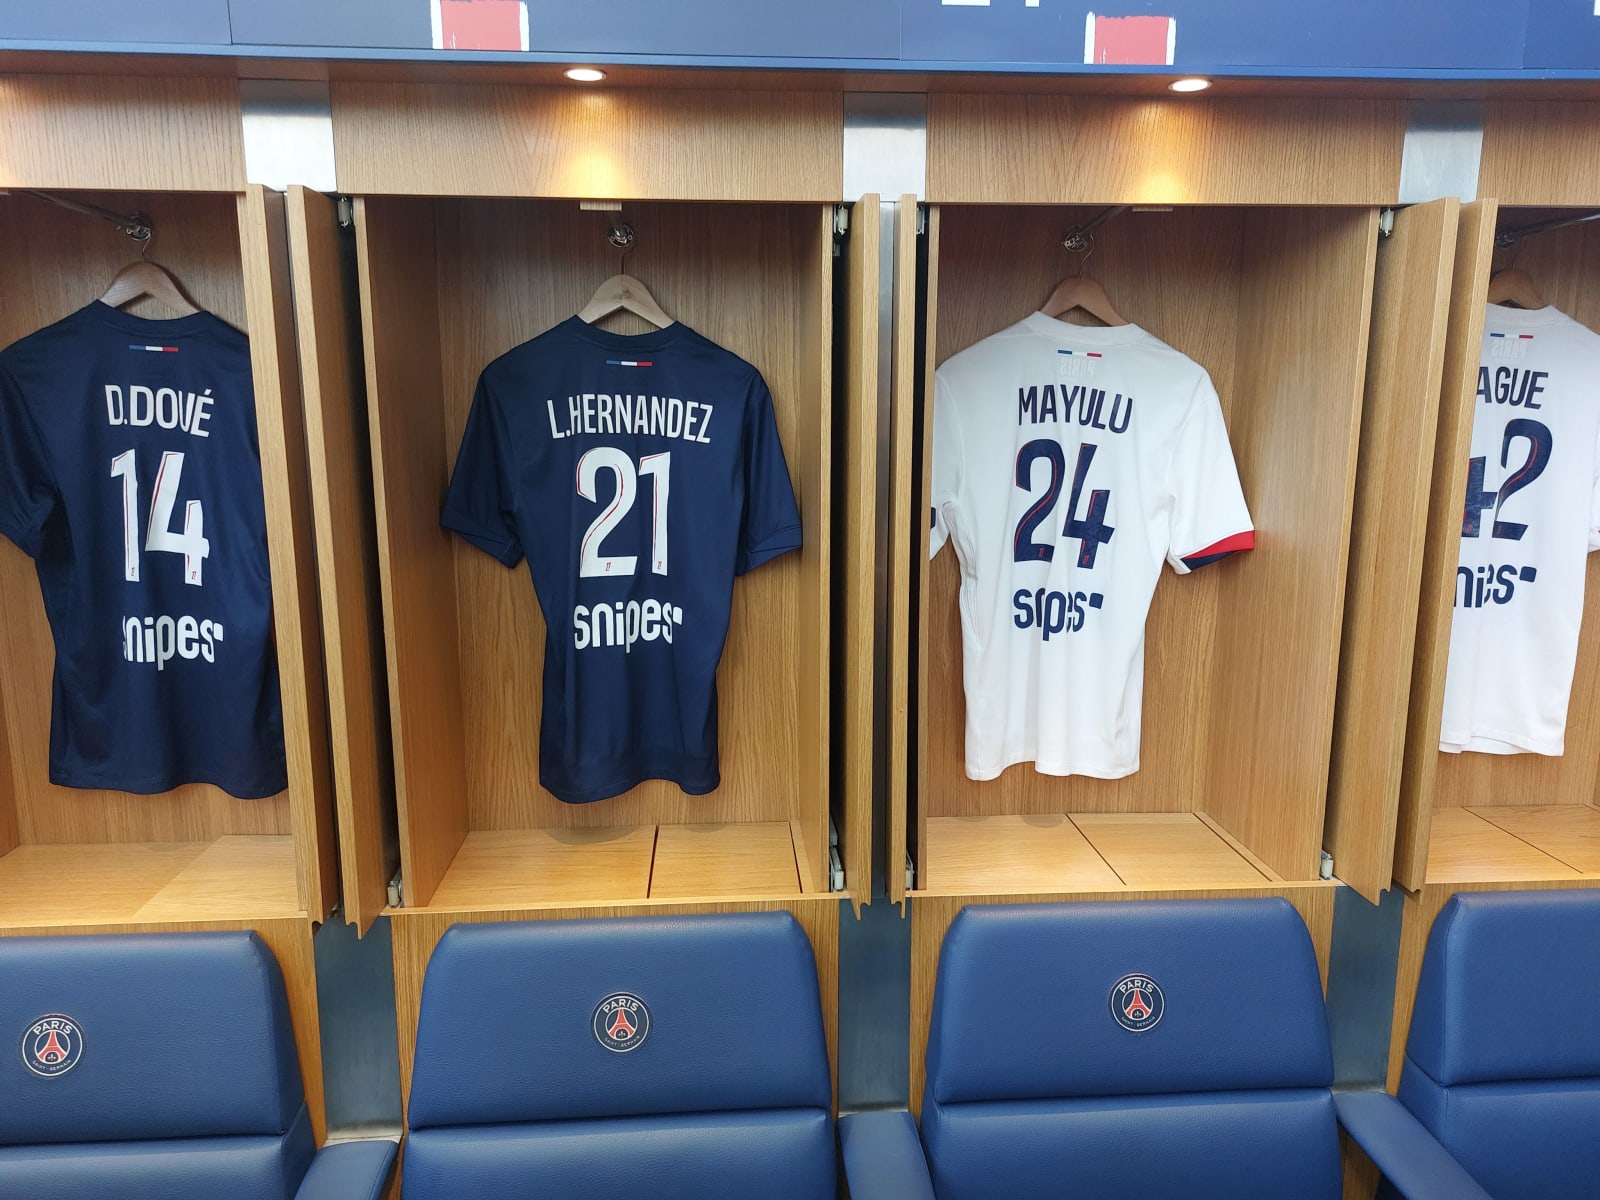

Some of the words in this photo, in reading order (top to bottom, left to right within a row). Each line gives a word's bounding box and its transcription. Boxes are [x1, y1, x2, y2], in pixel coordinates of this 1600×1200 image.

[547, 393, 714, 444] L.HERNANDEZ
[1018, 383, 1134, 434] MAYULU
[110, 448, 210, 587] 14
[576, 446, 671, 578] 21
[1013, 438, 1116, 570] 24
[573, 598, 673, 654] snipes
[602, 998, 639, 1014] PARIS
[1120, 979, 1154, 994] PARIS
[33, 1020, 73, 1035] PARIS
